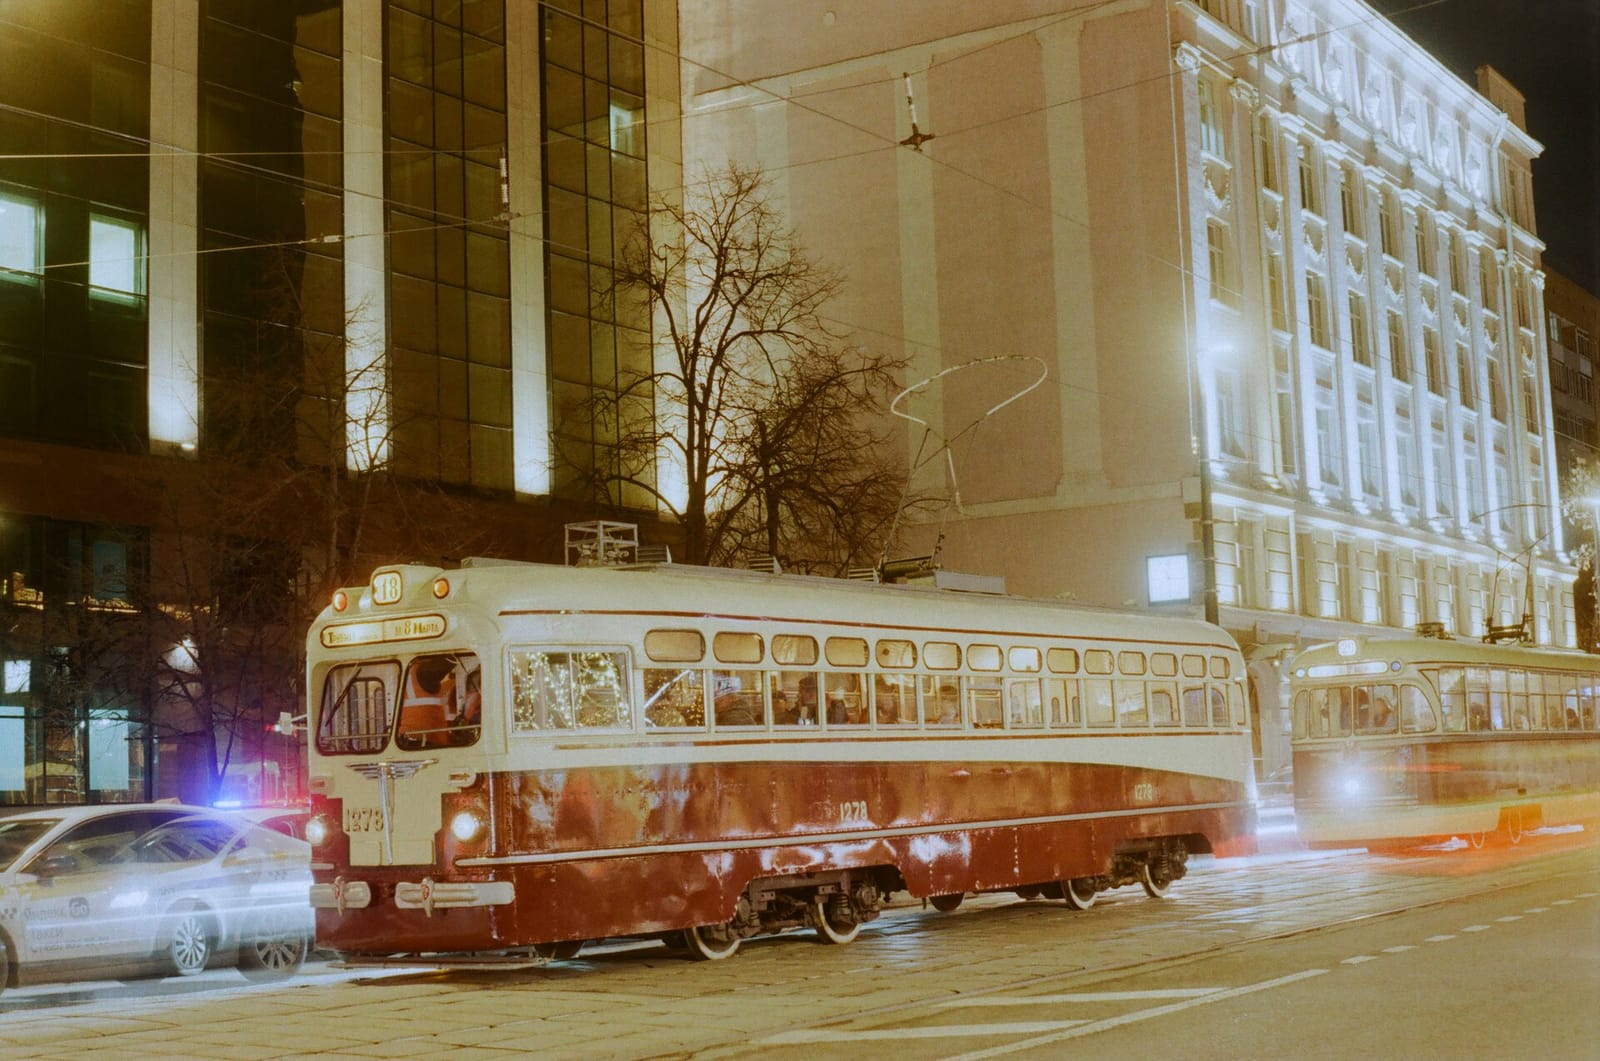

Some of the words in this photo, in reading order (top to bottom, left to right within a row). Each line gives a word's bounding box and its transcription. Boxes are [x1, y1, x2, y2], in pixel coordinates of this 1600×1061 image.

[381, 577, 398, 600] 18
[404, 620, 411, 635] 8
[345, 808, 384, 832] 1278
[840, 800, 868, 822] 1278
